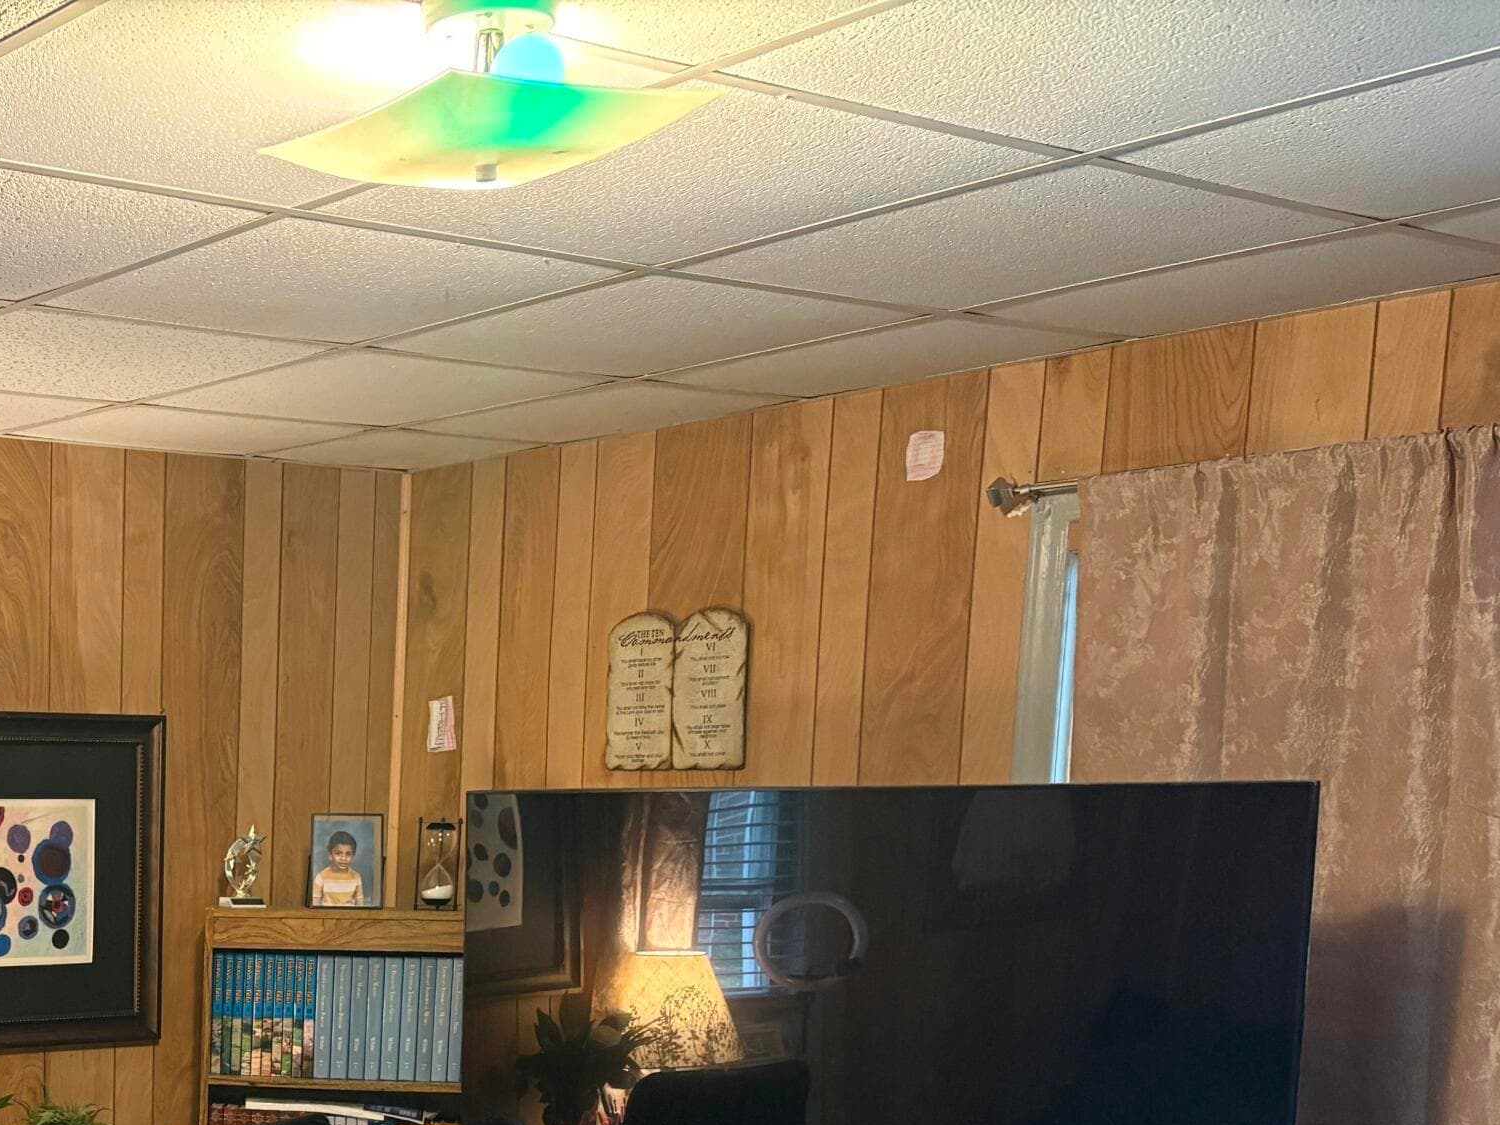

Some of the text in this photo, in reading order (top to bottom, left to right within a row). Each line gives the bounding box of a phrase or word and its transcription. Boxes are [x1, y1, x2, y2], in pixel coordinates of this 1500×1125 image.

[619, 622, 736, 648] Commandments
[637, 628, 665, 639] THE TEN
